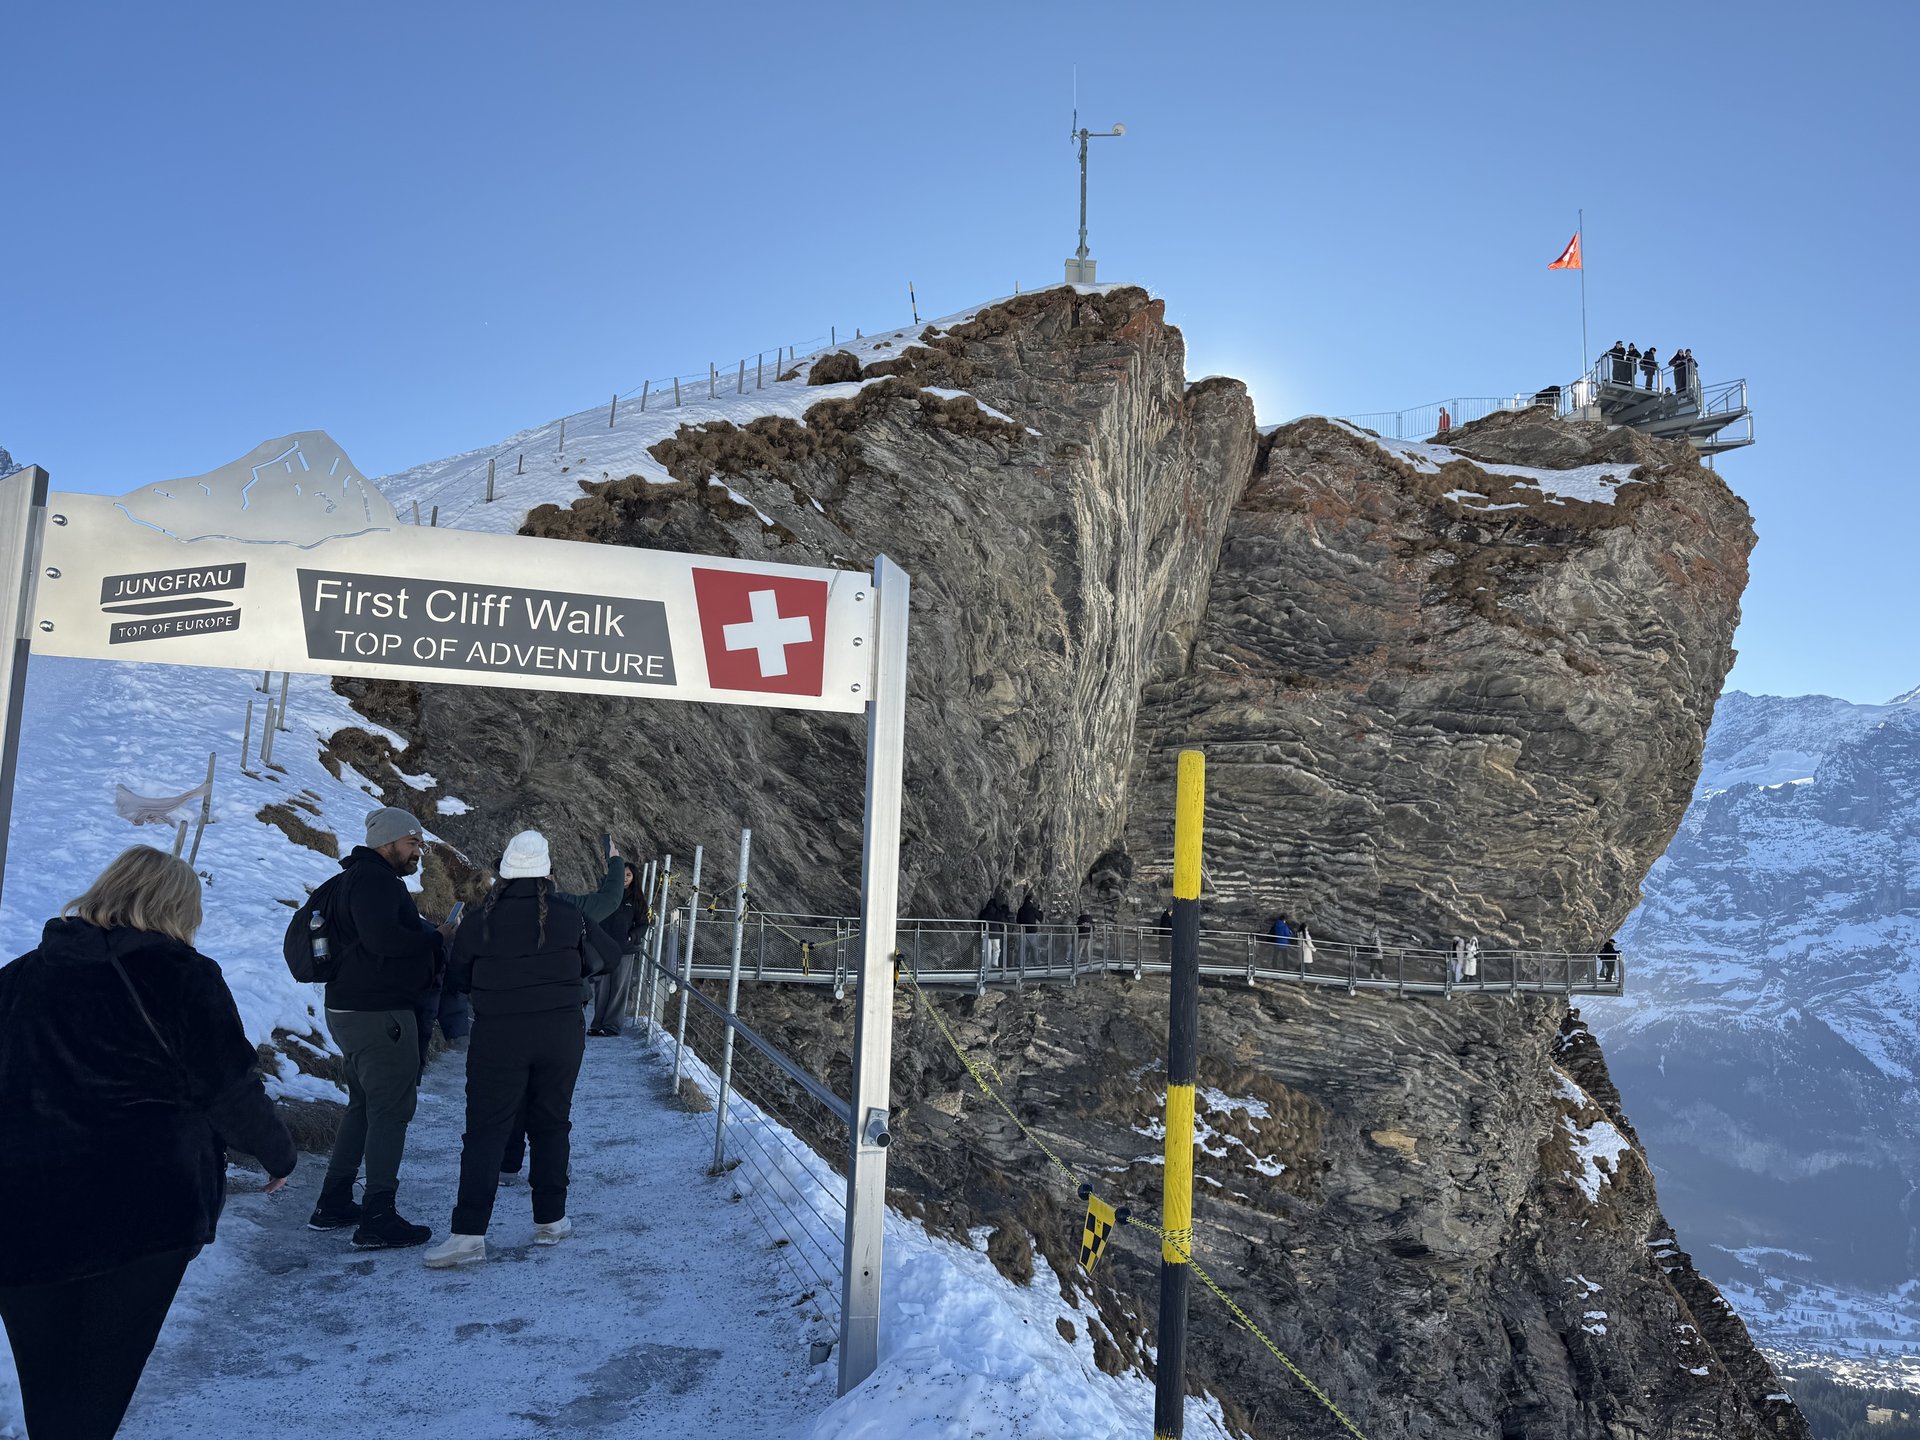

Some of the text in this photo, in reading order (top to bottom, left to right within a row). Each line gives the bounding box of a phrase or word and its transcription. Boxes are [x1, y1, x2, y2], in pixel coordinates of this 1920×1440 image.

[114, 569, 232, 596] JUNGFRAU
[118, 615, 233, 638] TOP OF EUROPE
[314, 579, 625, 638] First Cliff Walk
[334, 630, 665, 678] TOP OF ADVENTURE
